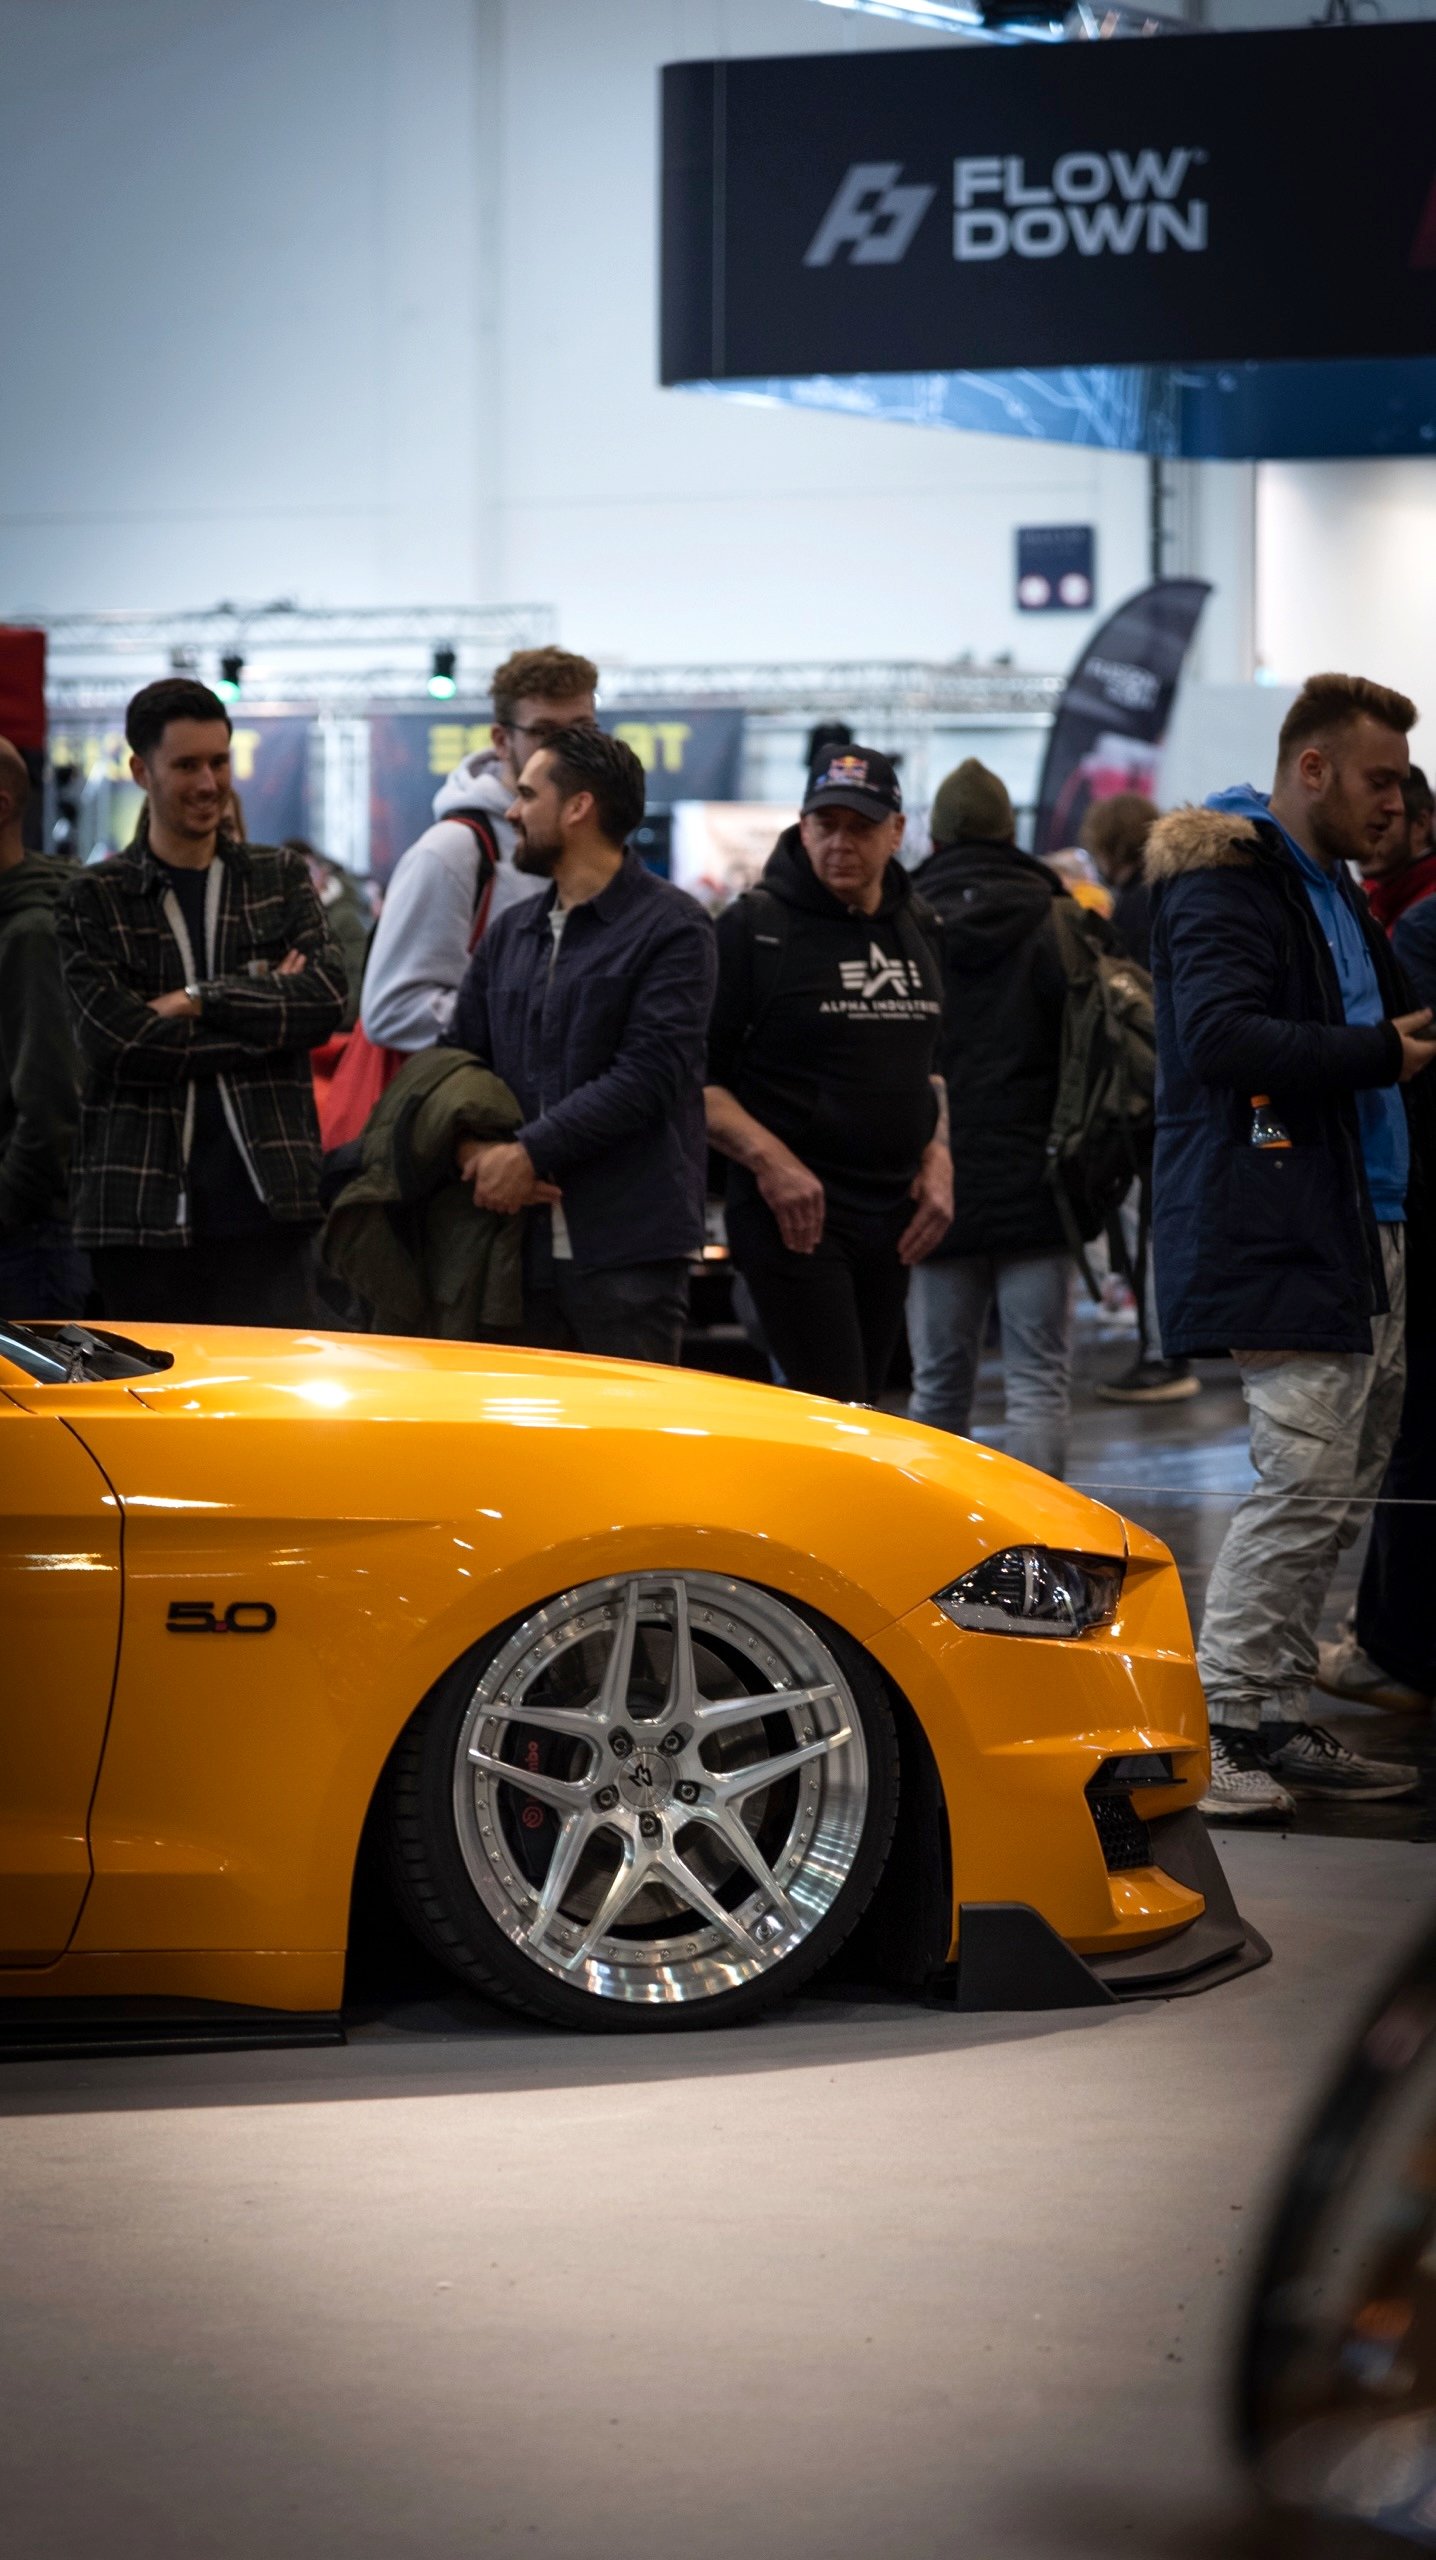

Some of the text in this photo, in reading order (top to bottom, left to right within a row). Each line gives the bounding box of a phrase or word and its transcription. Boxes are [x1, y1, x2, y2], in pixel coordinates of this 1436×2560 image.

[953, 147, 1192, 208] FLOW
[953, 200, 1208, 261] DOWN
[819, 1001, 869, 1013] ALPHA
[166, 1601, 277, 1633] 5.0
